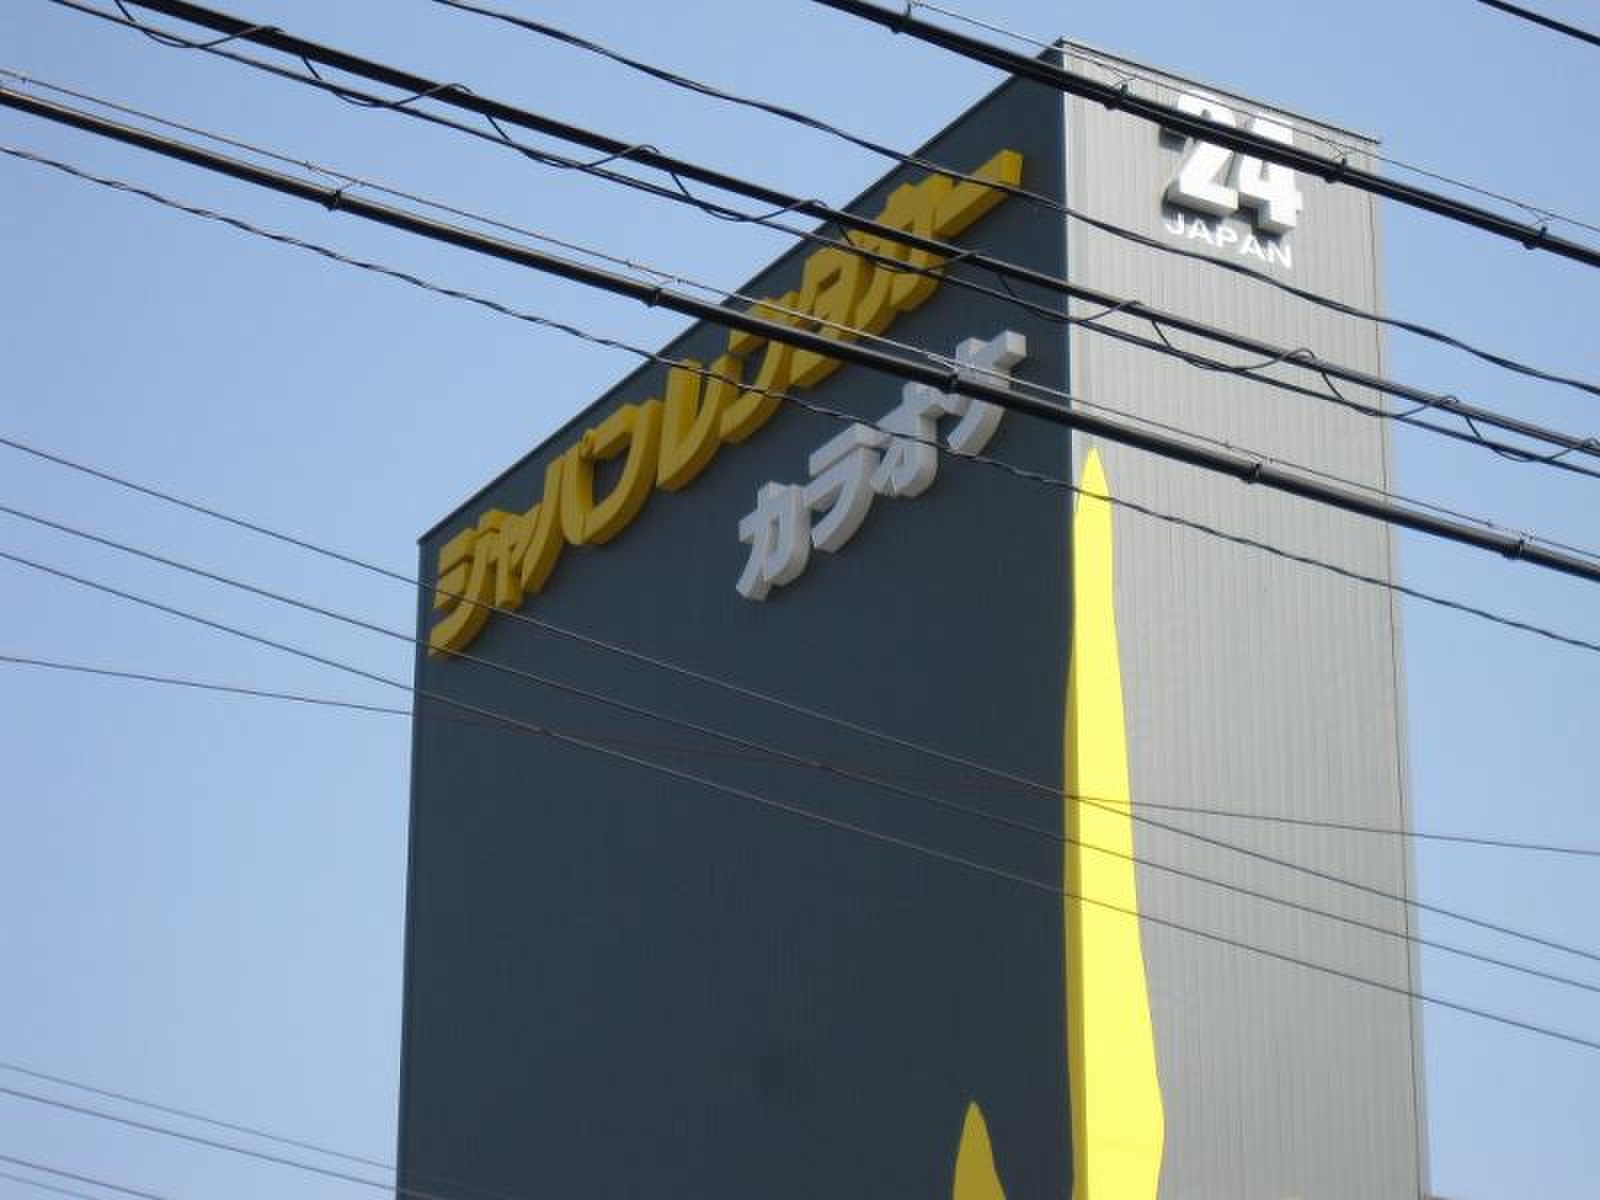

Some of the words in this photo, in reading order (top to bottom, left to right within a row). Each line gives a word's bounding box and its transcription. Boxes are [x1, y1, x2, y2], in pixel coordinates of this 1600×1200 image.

[1164, 212, 1293, 269] JAPAN
[1167, 92, 1303, 229] 24
[429, 149, 1023, 658] ジャパンレンタカー
[736, 329, 1027, 601] カラオケ
